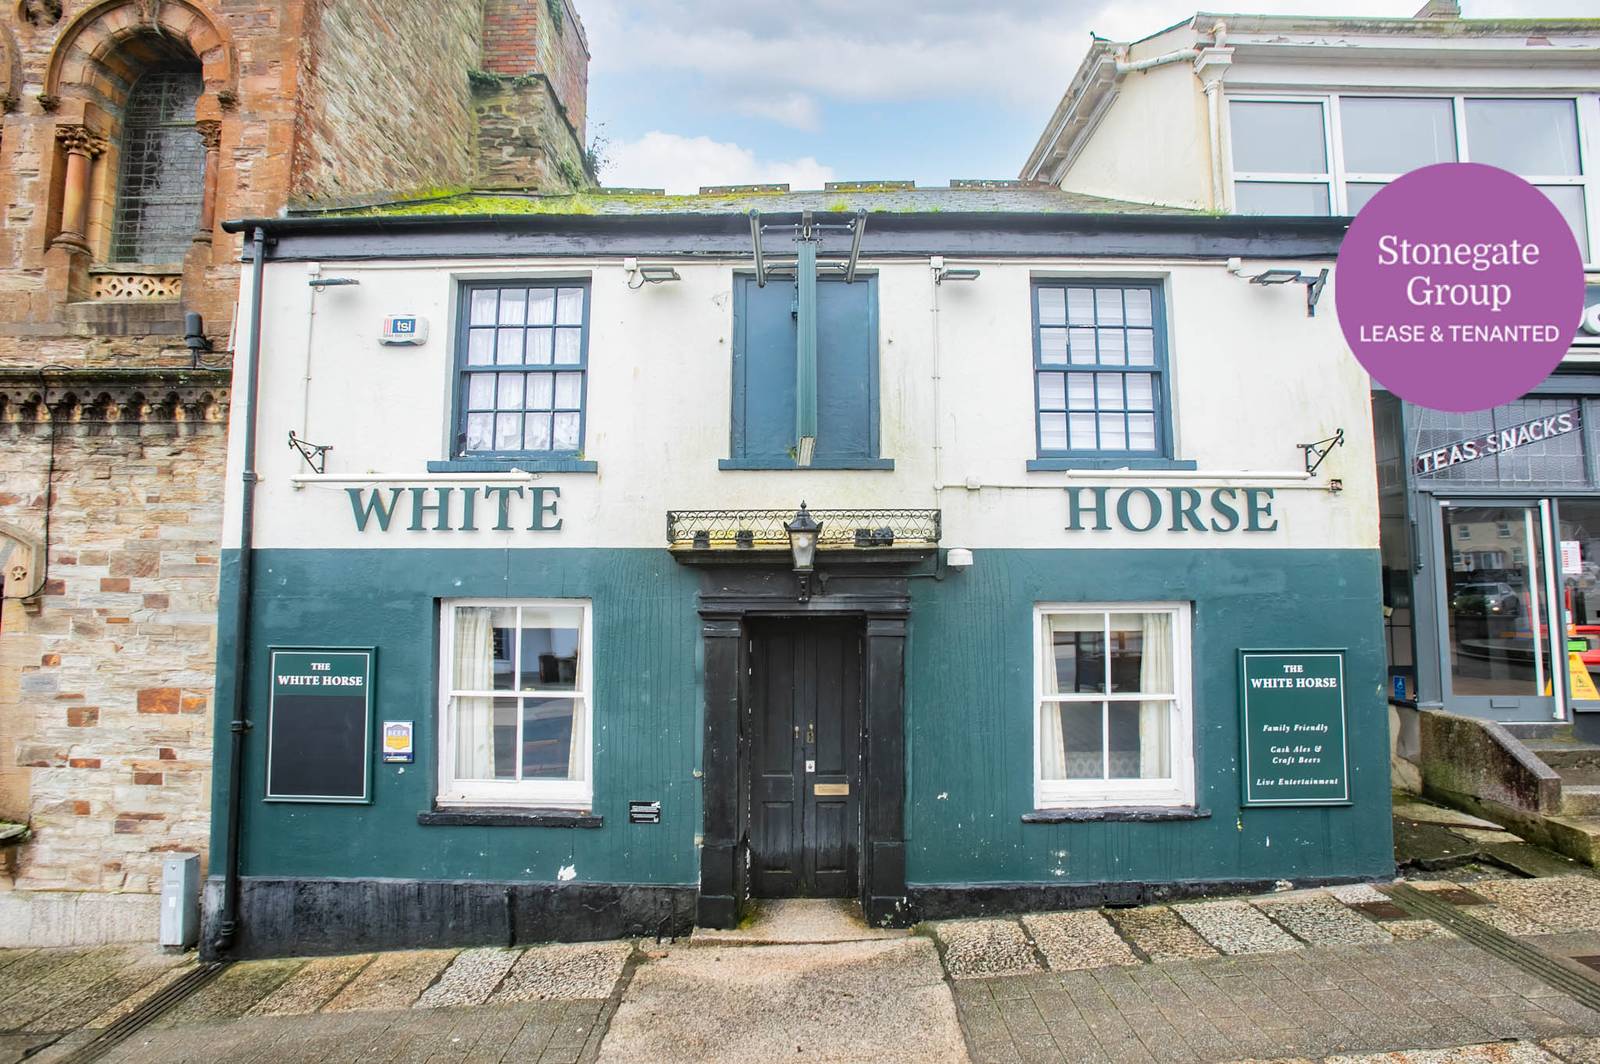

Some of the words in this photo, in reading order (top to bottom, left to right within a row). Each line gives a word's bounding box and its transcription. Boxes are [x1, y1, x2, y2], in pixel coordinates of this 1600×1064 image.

[1486, 413, 1573, 453] SNACKS
[344, 485, 563, 532] WHITE
[1064, 486, 1278, 532] HORSE
[310, 662, 331, 671] THE
[1283, 664, 1304, 673] THE
[278, 675, 320, 686] WHITE
[322, 675, 364, 686] HORSE
[1251, 678, 1293, 688] WHITE
[1296, 677, 1337, 688] HORSE
[1263, 724, 1290, 734] Family
[1293, 723, 1328, 733] Friendly
[1270, 745, 1290, 753] Cask
[1293, 745, 1311, 753] Ales
[1314, 745, 1322, 753] &
[1272, 756, 1295, 766] Craft
[1298, 756, 1321, 764] Beers
[1256, 778, 1275, 786] Live
[1278, 778, 1338, 786] Entertainment
